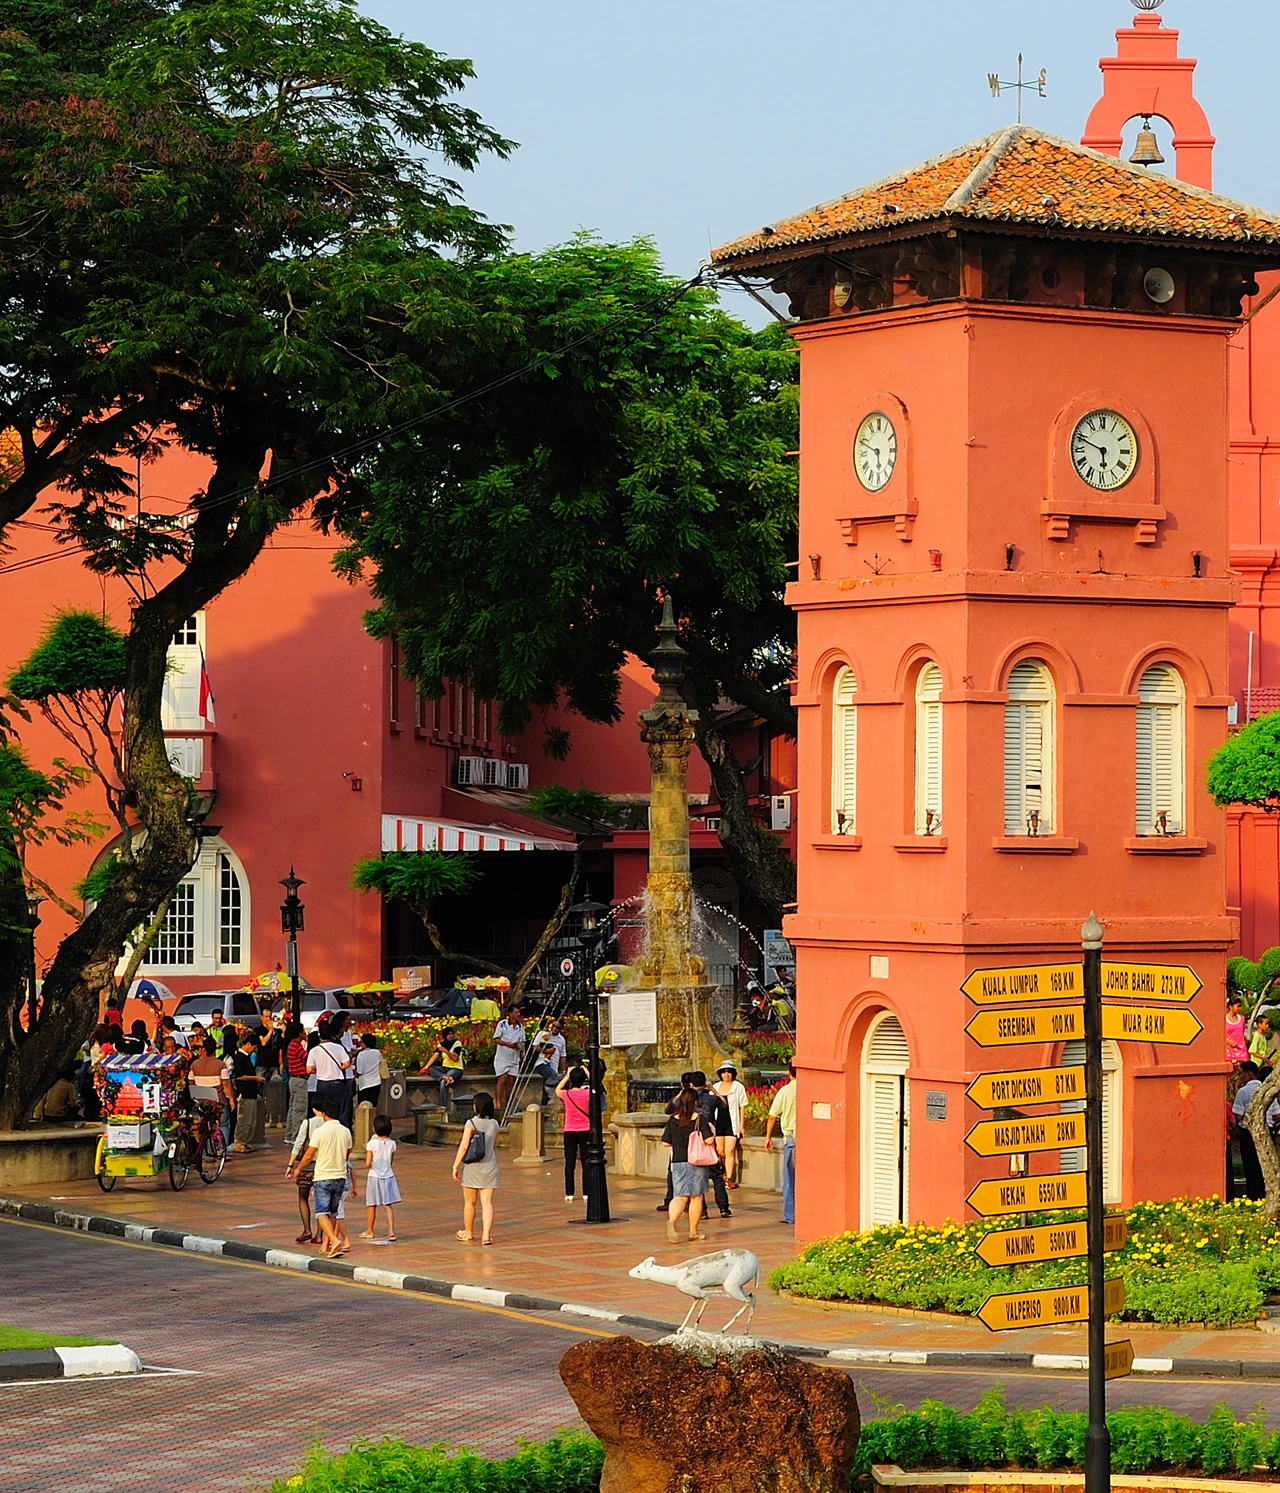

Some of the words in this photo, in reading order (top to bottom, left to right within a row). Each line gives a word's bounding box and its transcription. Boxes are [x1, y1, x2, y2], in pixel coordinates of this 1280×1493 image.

[982, 976, 1007, 996] KUALA
[1010, 974, 1039, 995] LUMPUR
[1050, 973, 1062, 992] 168
[1063, 971, 1075, 990] KM
[1105, 970, 1129, 990] JOHOR
[1131, 972, 1155, 992] BAHRU
[1161, 974, 1173, 993] 273
[1174, 975, 1185, 995] KM
[998, 1016, 1036, 1037] SEREMBAN
[1051, 1015, 1063, 1034] 100
[1064, 1013, 1075, 1033] KM
[1122, 1013, 1142, 1033] MUAR
[1144, 1015, 1153, 1034] 48
[1154, 1015, 1165, 1034] KM
[991, 1080, 1010, 1100] PORT
[1011, 1077, 1042, 1098] DICKSON
[1055, 1074, 1064, 1094] 87
[1065, 1073, 1076, 1093] KM
[995, 1126, 1020, 1147] MASJID
[1021, 1124, 1046, 1145] TANAH
[1000, 1185, 1026, 1206] MEKAH
[1038, 1184, 1055, 1203] 6550
[1056, 1181, 1067, 1201] KM
[1005, 1234, 1035, 1257] NANJING
[1049, 1231, 1065, 1251] 5500
[1066, 1230, 1077, 1250] KM
[1005, 1299, 1042, 1322] VALPERISO
[1053, 1296, 1069, 1316] 9800
[1070, 1295, 1080, 1314] KM
